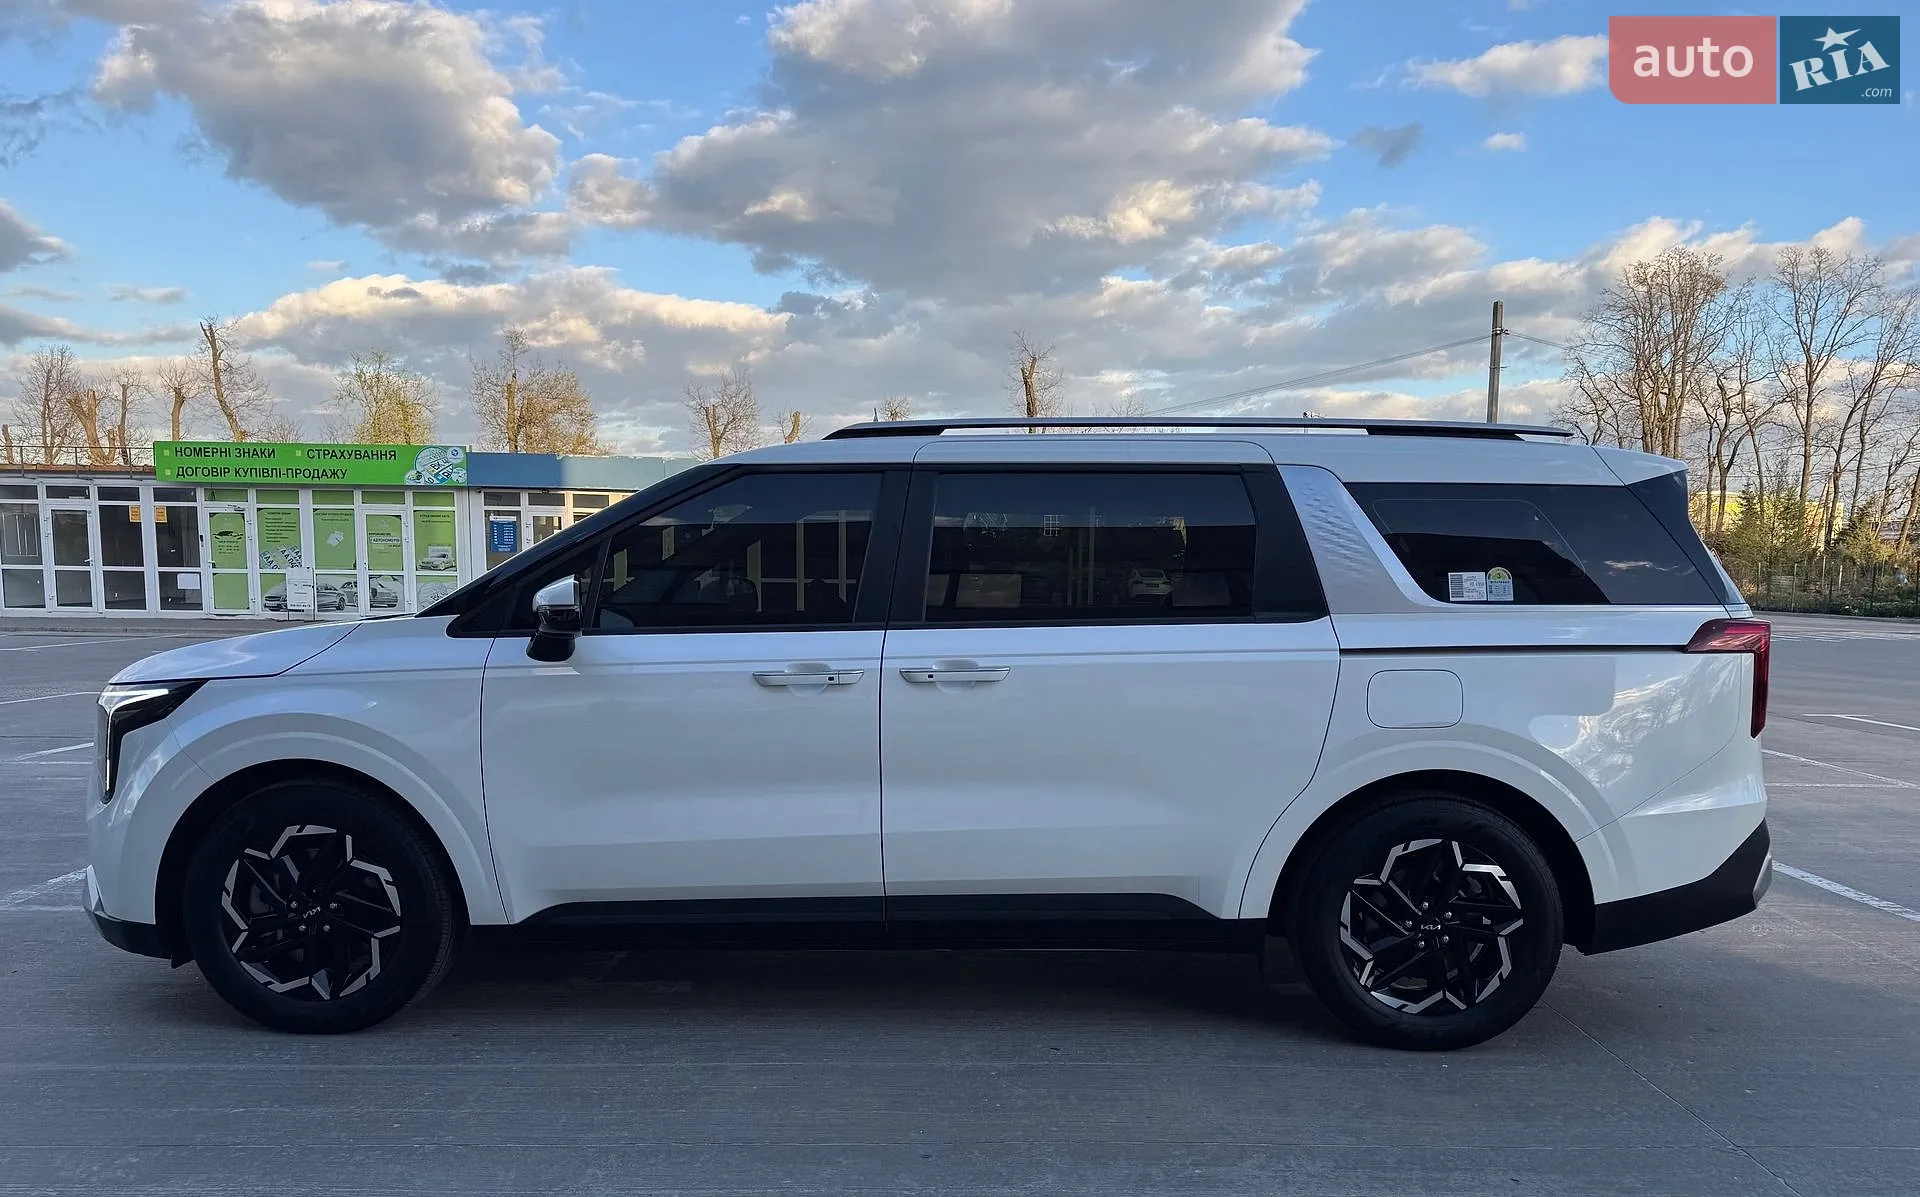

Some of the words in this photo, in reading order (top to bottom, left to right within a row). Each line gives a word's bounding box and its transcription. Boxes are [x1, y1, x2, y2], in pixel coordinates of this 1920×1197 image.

[175, 446, 231, 458] НОМЕРНІ
[235, 448, 276, 459] ЗНАКИ
[306, 448, 397, 461] СТРАХУВАННЯ
[176, 466, 231, 479] ДОГОВІР
[234, 467, 348, 480] КУПІВЛІ-ПРОДАЖУ
